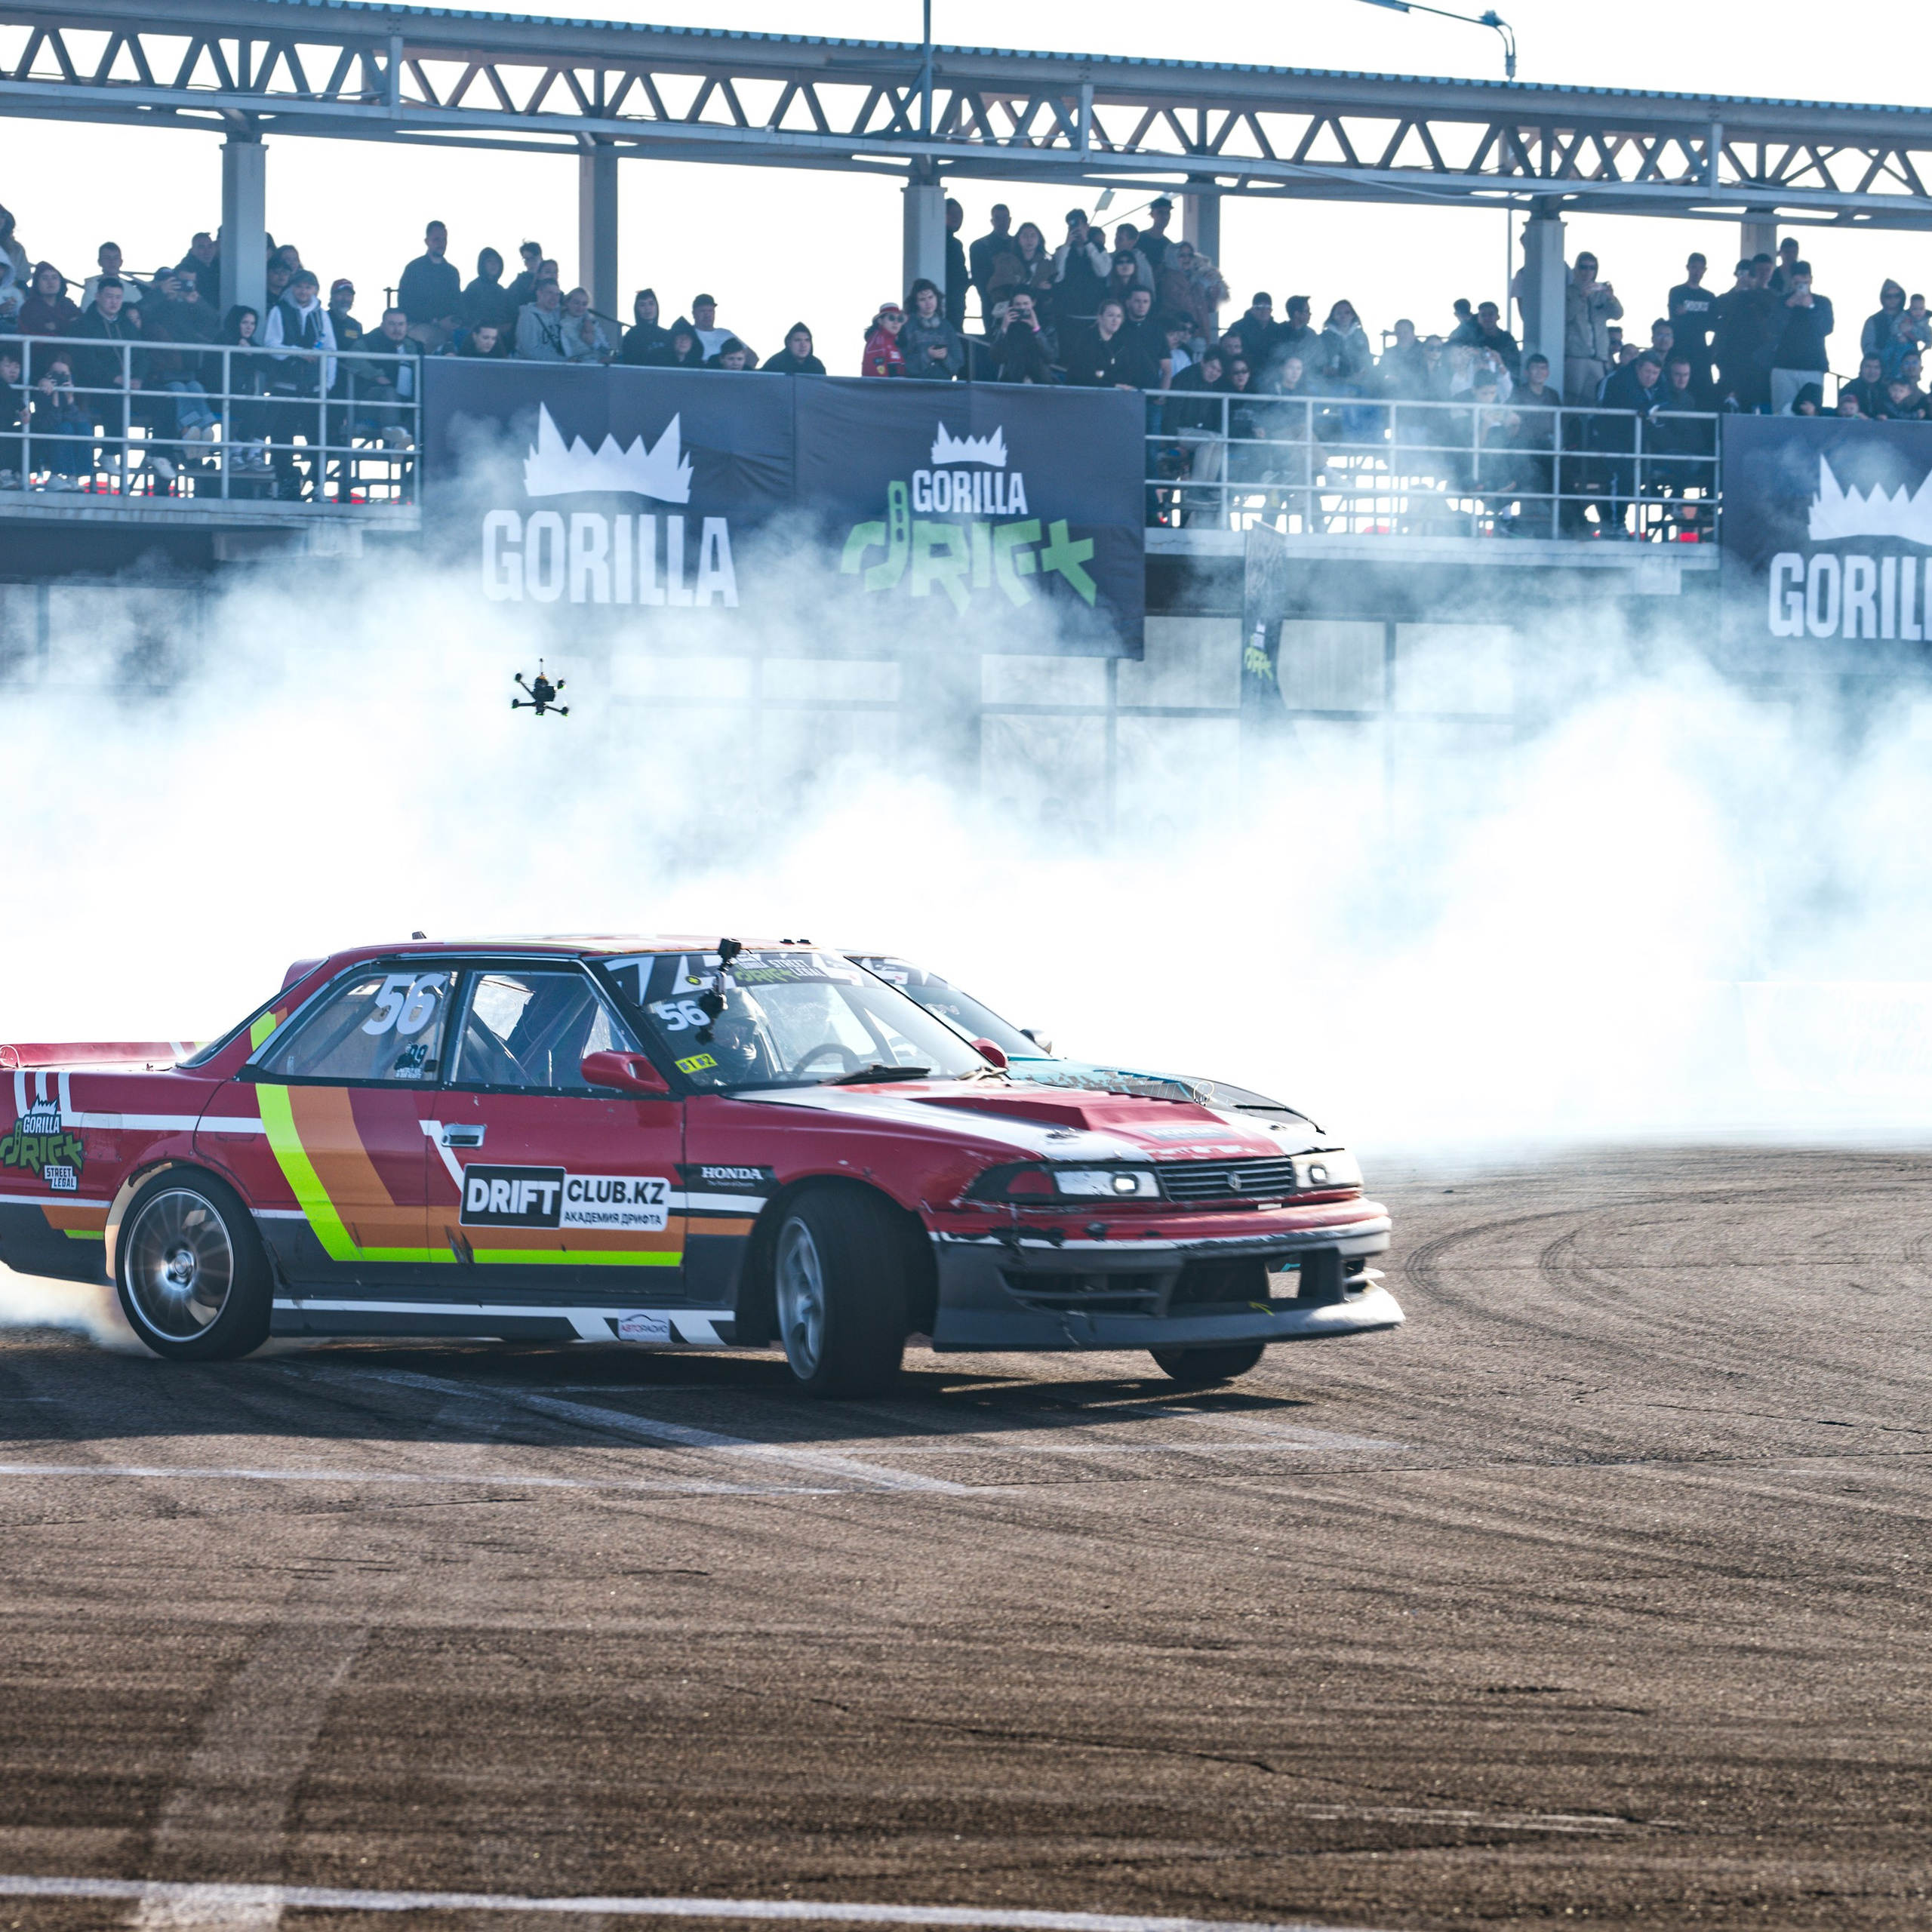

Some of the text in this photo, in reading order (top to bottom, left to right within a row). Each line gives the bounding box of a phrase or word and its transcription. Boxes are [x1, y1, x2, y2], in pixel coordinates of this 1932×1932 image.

[912, 469, 1029, 515] GORILLA
[482, 509, 740, 608] GORILLA
[767, 959, 811, 968] STREET
[788, 967, 827, 977] LEGAL
[361, 974, 448, 1035] 56
[654, 1000, 711, 1031] 56
[23, 1116, 60, 1134] GORILLA
[47, 1168, 72, 1177] STREET
[700, 1167, 764, 1180] HONDA
[54, 1178, 75, 1187] LEGAL
[466, 1178, 665, 1215] DRIFT CLUB.KZ
[565, 1211, 662, 1226] АКАДЕМИЯ ДРИФТА
